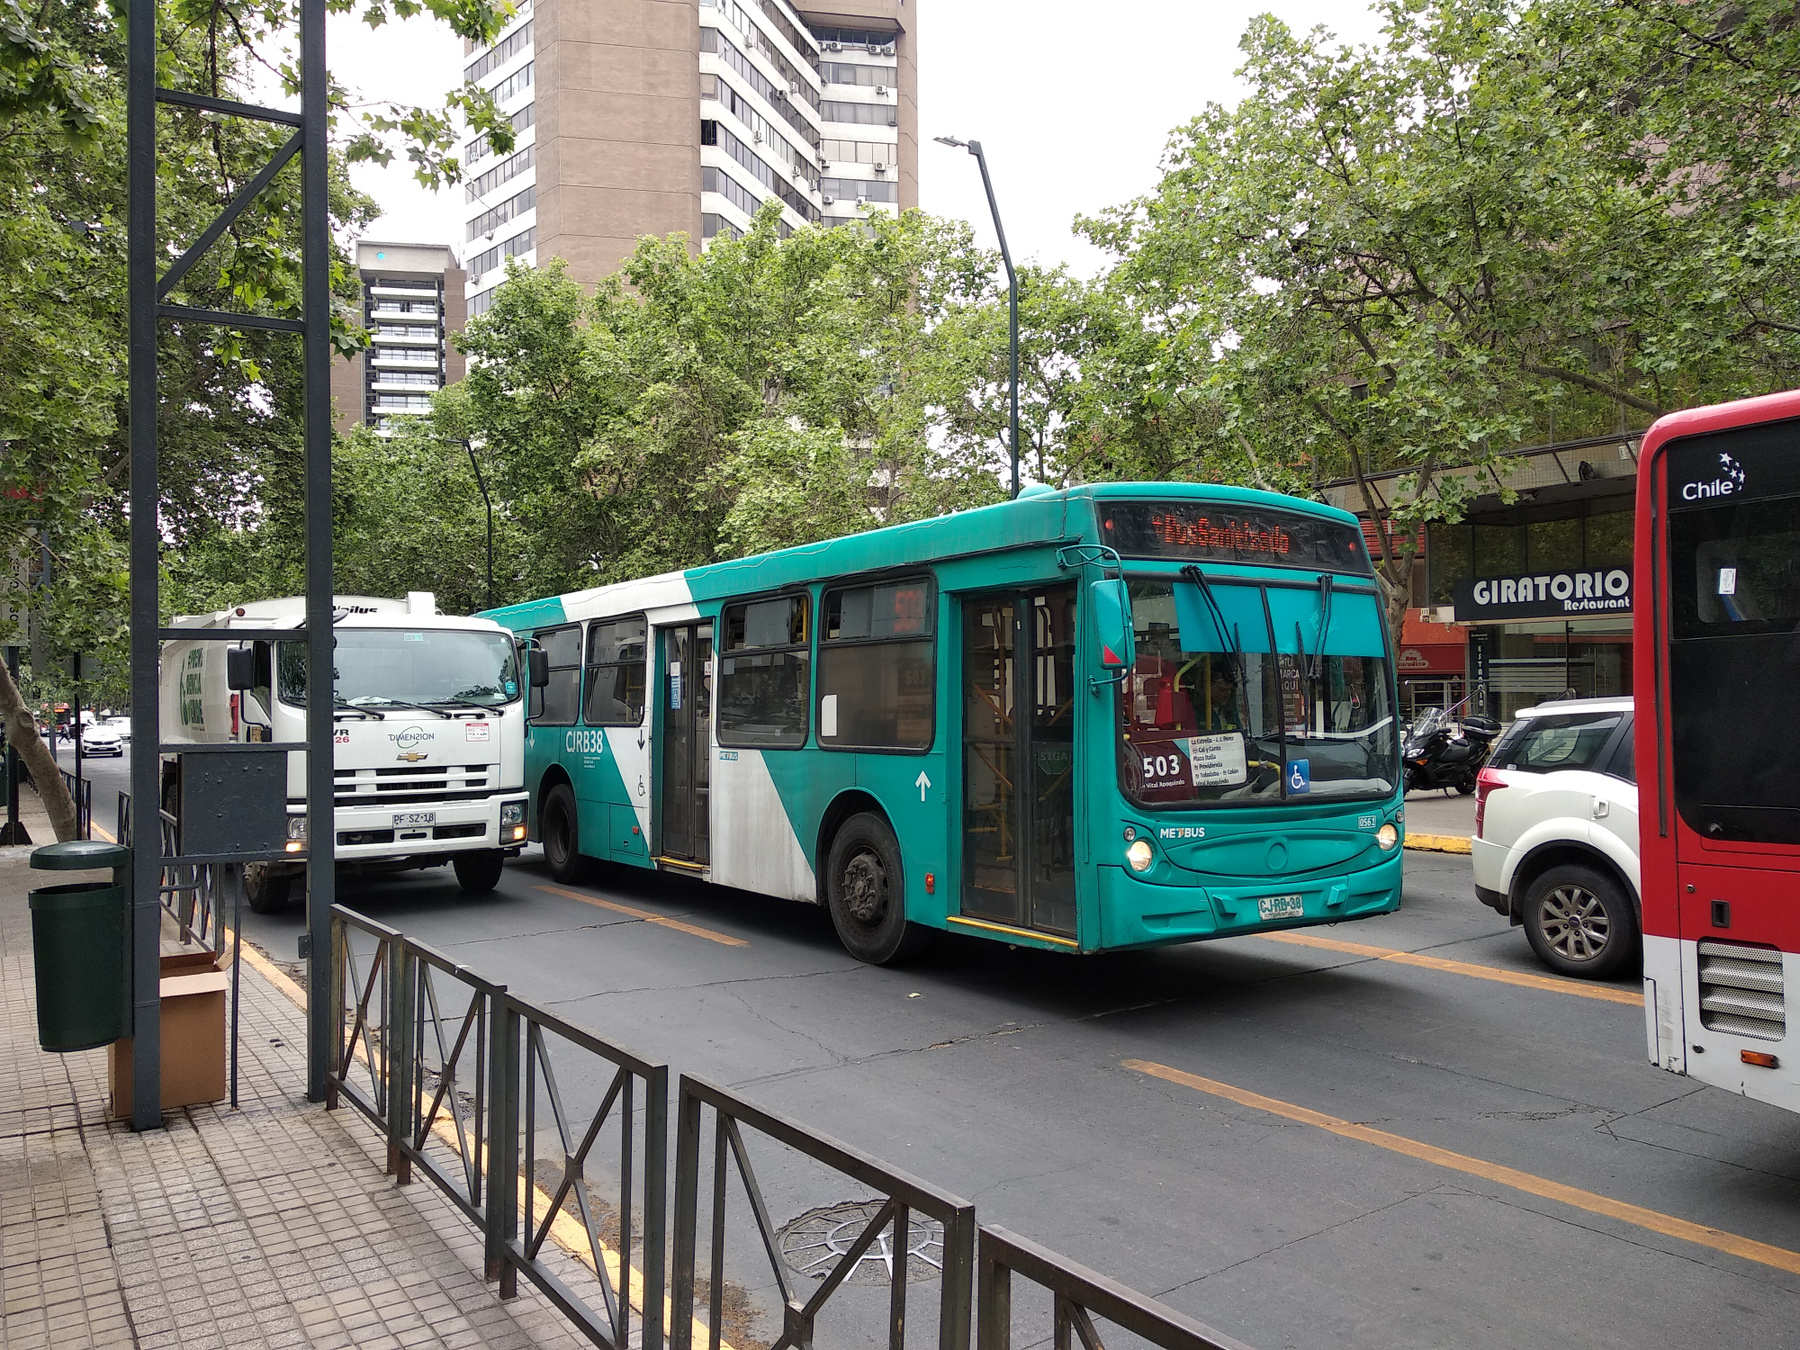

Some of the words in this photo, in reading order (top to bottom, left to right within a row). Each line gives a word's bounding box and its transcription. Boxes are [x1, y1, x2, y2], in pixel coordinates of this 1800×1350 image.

[1682, 478, 1734, 500] Chile
[1473, 569, 1630, 605] GIRATORIO
[1564, 596, 1630, 611] Restaurant
[565, 730, 604, 753] CJRB38
[1040, 751, 1069, 761] SIGA
[1143, 754, 1180, 778] 503
